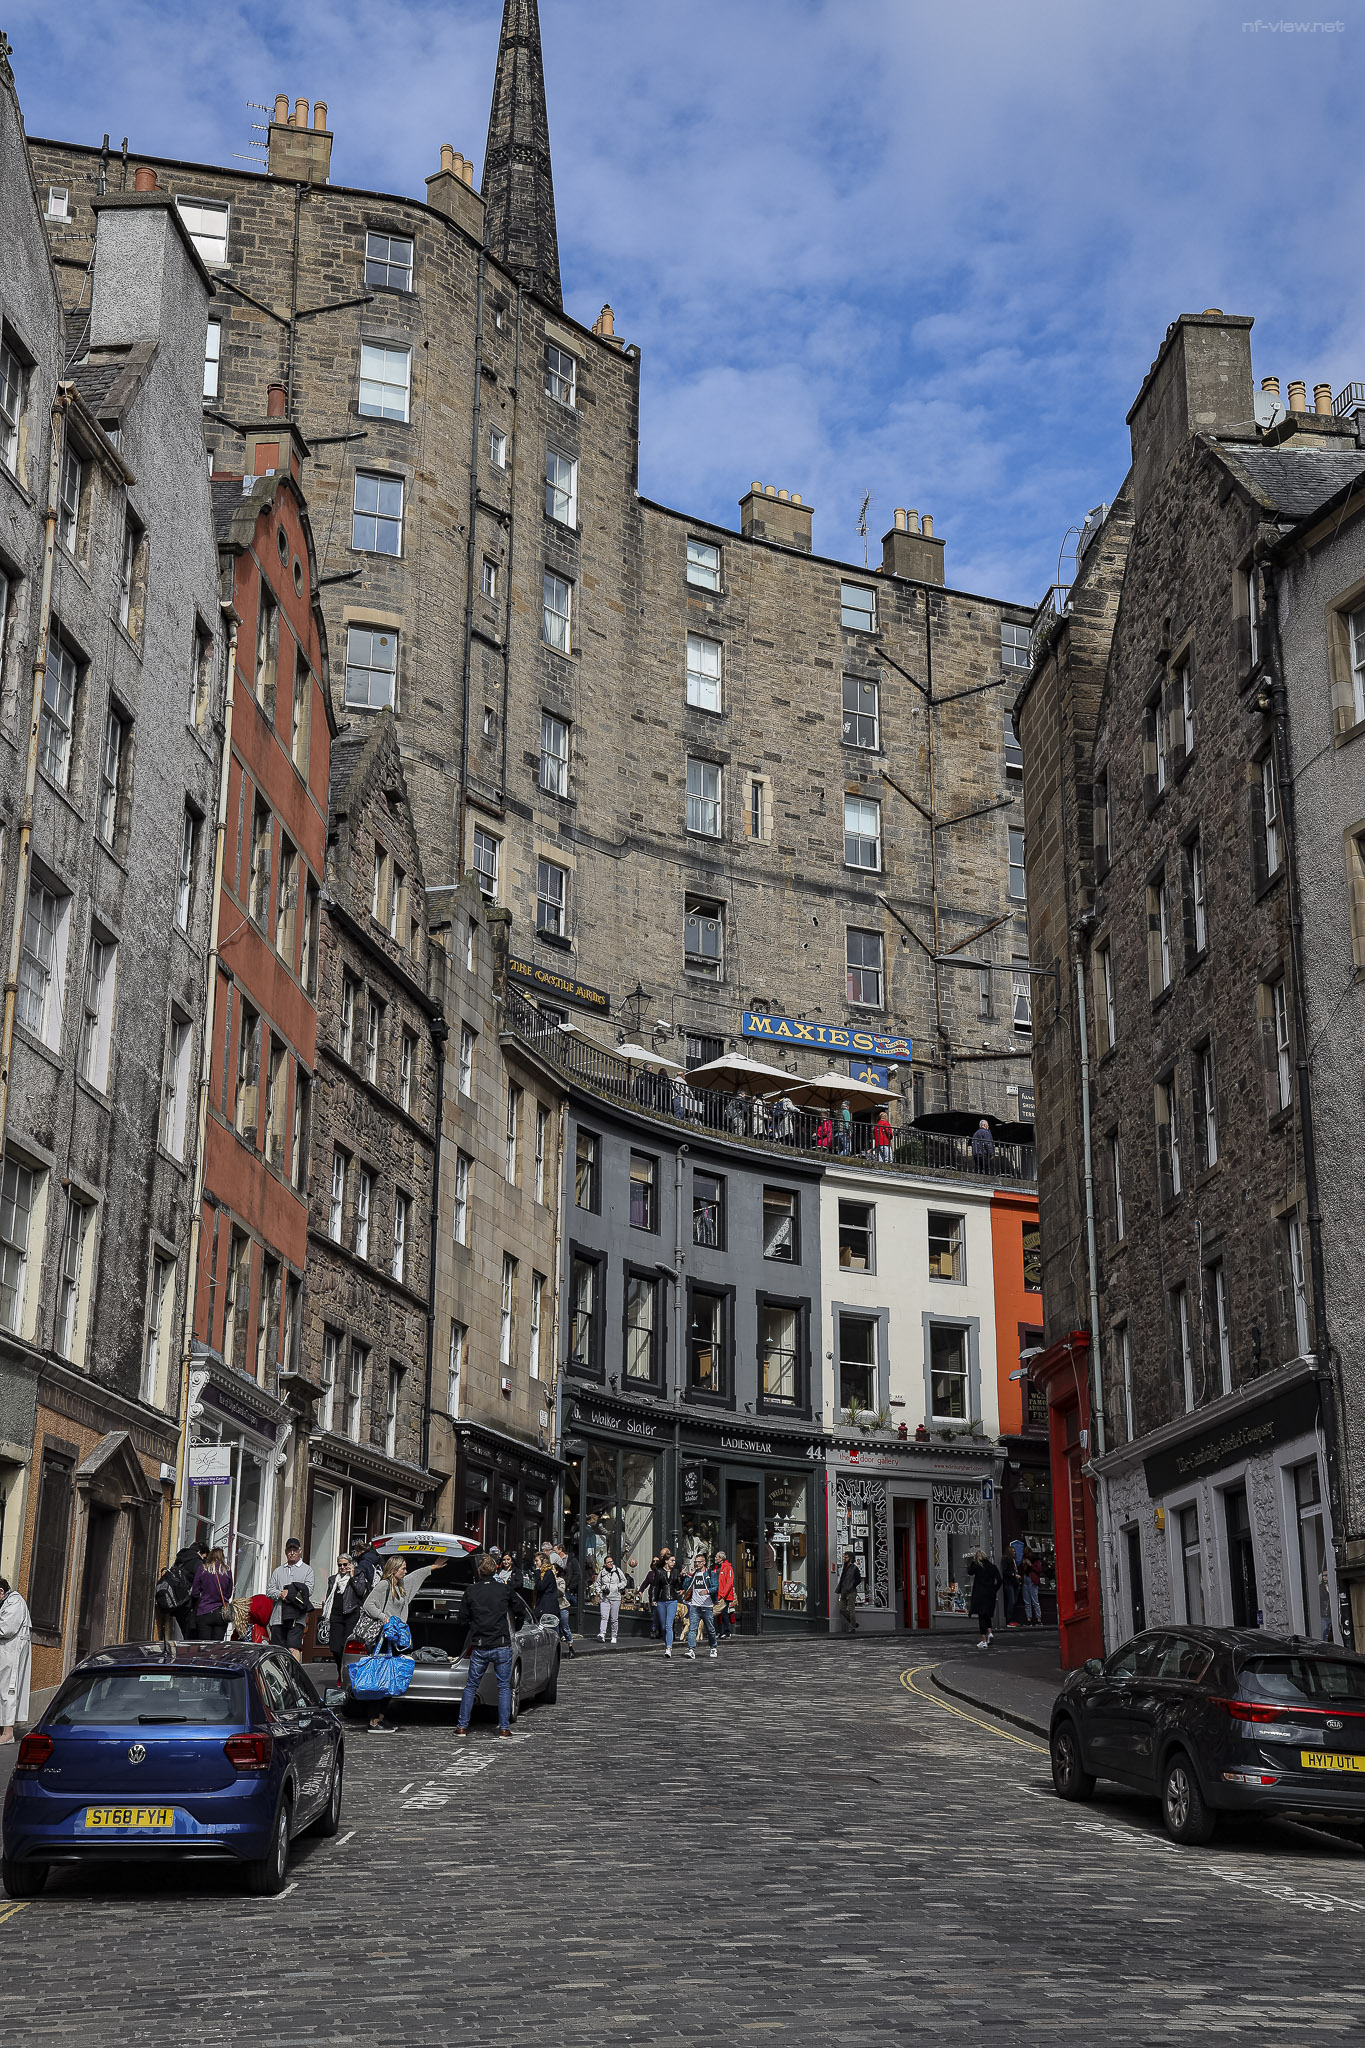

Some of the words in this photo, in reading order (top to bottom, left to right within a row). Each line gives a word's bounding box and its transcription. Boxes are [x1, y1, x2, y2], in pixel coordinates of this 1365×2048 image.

[509, 959, 533, 976] THE
[534, 970, 575, 993] CASTLE
[748, 1015, 874, 1050] MAXIES
[54, 1386, 96, 1423] BACCHUS
[591, 1410, 621, 1429] Walker
[627, 1417, 657, 1436] Slater
[128, 1424, 167, 1458] NTIQUES
[721, 1436, 772, 1454] LADIESWEAR
[805, 1445, 826, 1461] 44.
[839, 1452, 850, 1461] the
[860, 1455, 875, 1463] door
[877, 1456, 899, 1467] gallery
[1308, 1753, 1334, 1767] HY17
[1337, 1756, 1360, 1770] UTL
[92, 1809, 133, 1825] ST68
[136, 1809, 167, 1825] FYH
